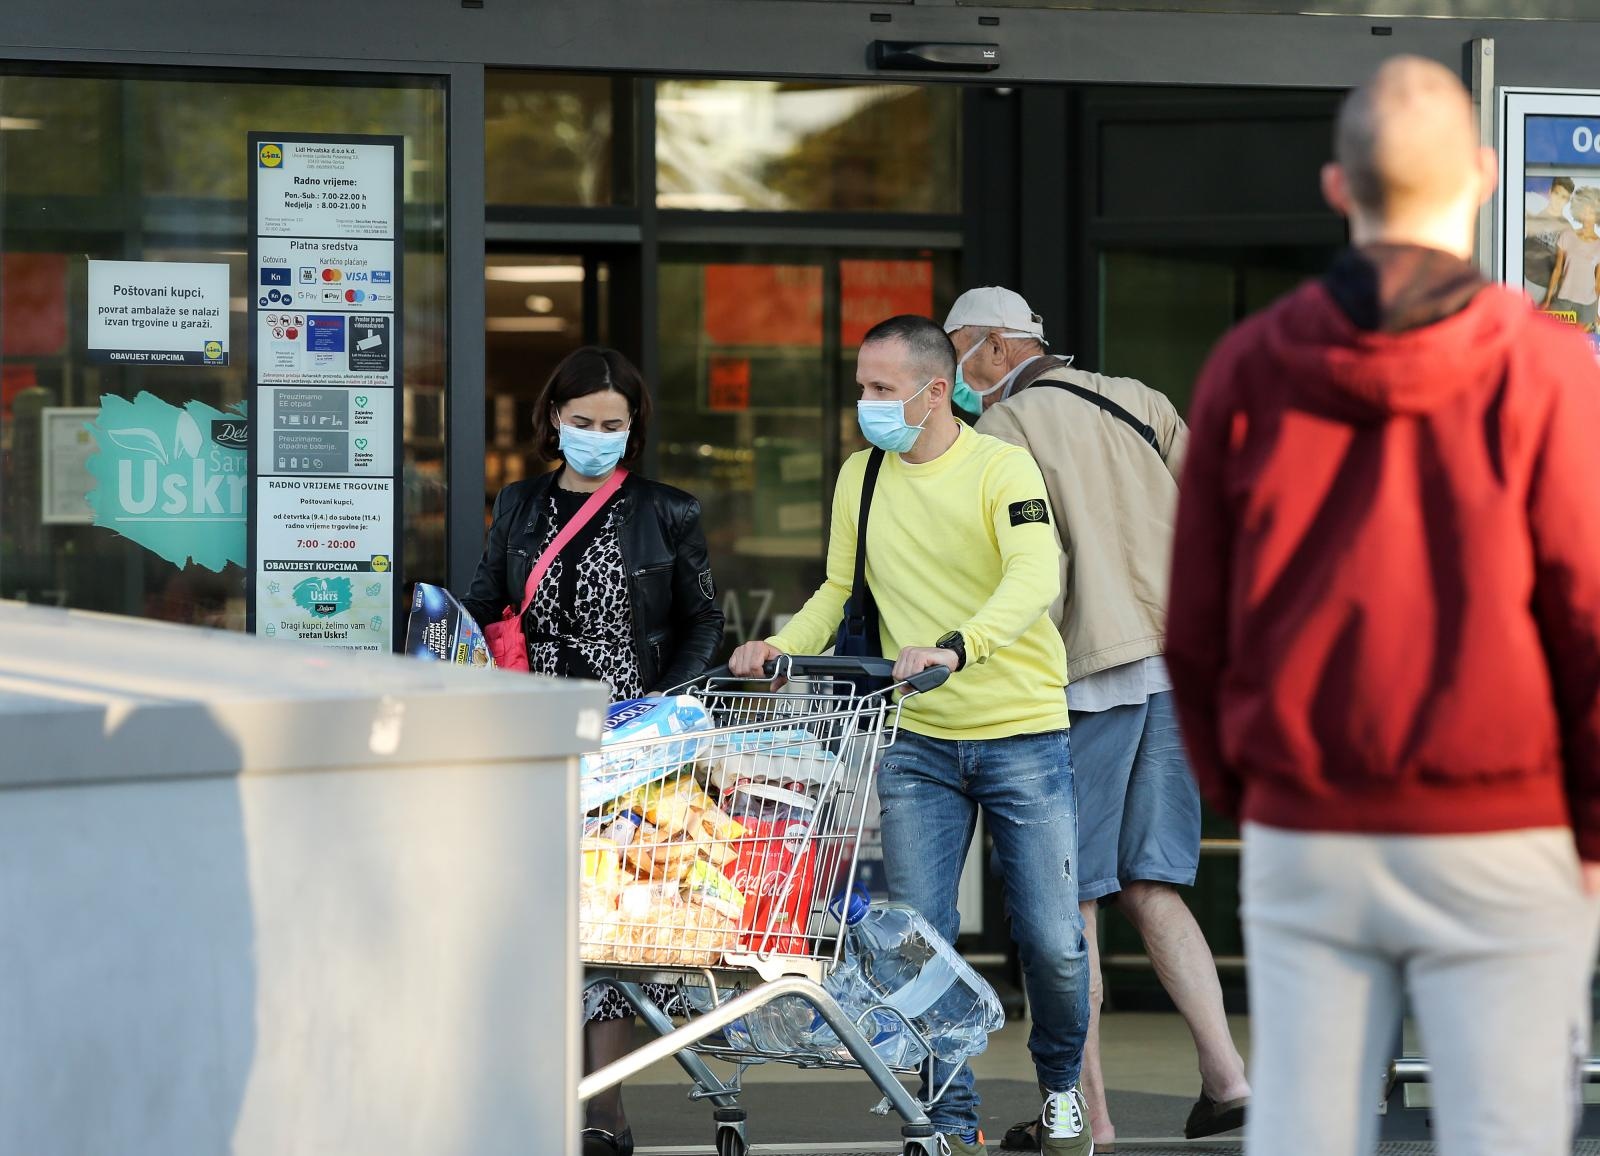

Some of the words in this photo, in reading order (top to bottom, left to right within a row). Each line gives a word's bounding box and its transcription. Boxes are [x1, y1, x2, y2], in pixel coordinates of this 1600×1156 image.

[294, 177, 321, 185] Radno
[323, 178, 357, 187] vrijeme:
[322, 202, 360, 210] 8.00-21.00
[291, 241, 319, 250] Platna
[322, 241, 358, 251] sredstva
[263, 256, 287, 264] Gotovina
[320, 258, 344, 266] Kartično
[344, 258, 368, 267] plaćanje
[346, 272, 368, 281] VISA
[114, 284, 167, 297] Poštovani
[171, 287, 204, 299] kupci,
[306, 292, 318, 300] Pay
[98, 306, 128, 315] povrat
[131, 306, 176, 315] ambalaže
[193, 307, 220, 316] nalazi
[105, 317, 129, 326] izvan
[132, 318, 169, 329] trgovine
[181, 319, 212, 330] garaži.
[151, 353, 184, 361] KUPCIMA
[310, 443, 336, 451] baterije.
[303, 482, 341, 490] VRIJEME
[343, 483, 389, 491] TRGOVINE
[362, 514, 381, 522] (11.4.)
[297, 540, 319, 548] 7:00
[328, 540, 356, 548] 20:00
[266, 562, 314, 570] OBAVIJEST
[316, 562, 358, 571] KUPCIMA
[311, 590, 338, 601] Uskrs
[281, 622, 301, 630] Dragi
[302, 622, 324, 631] kupci,
[326, 621, 349, 630] želimo
[324, 631, 348, 639] Uskrs!
